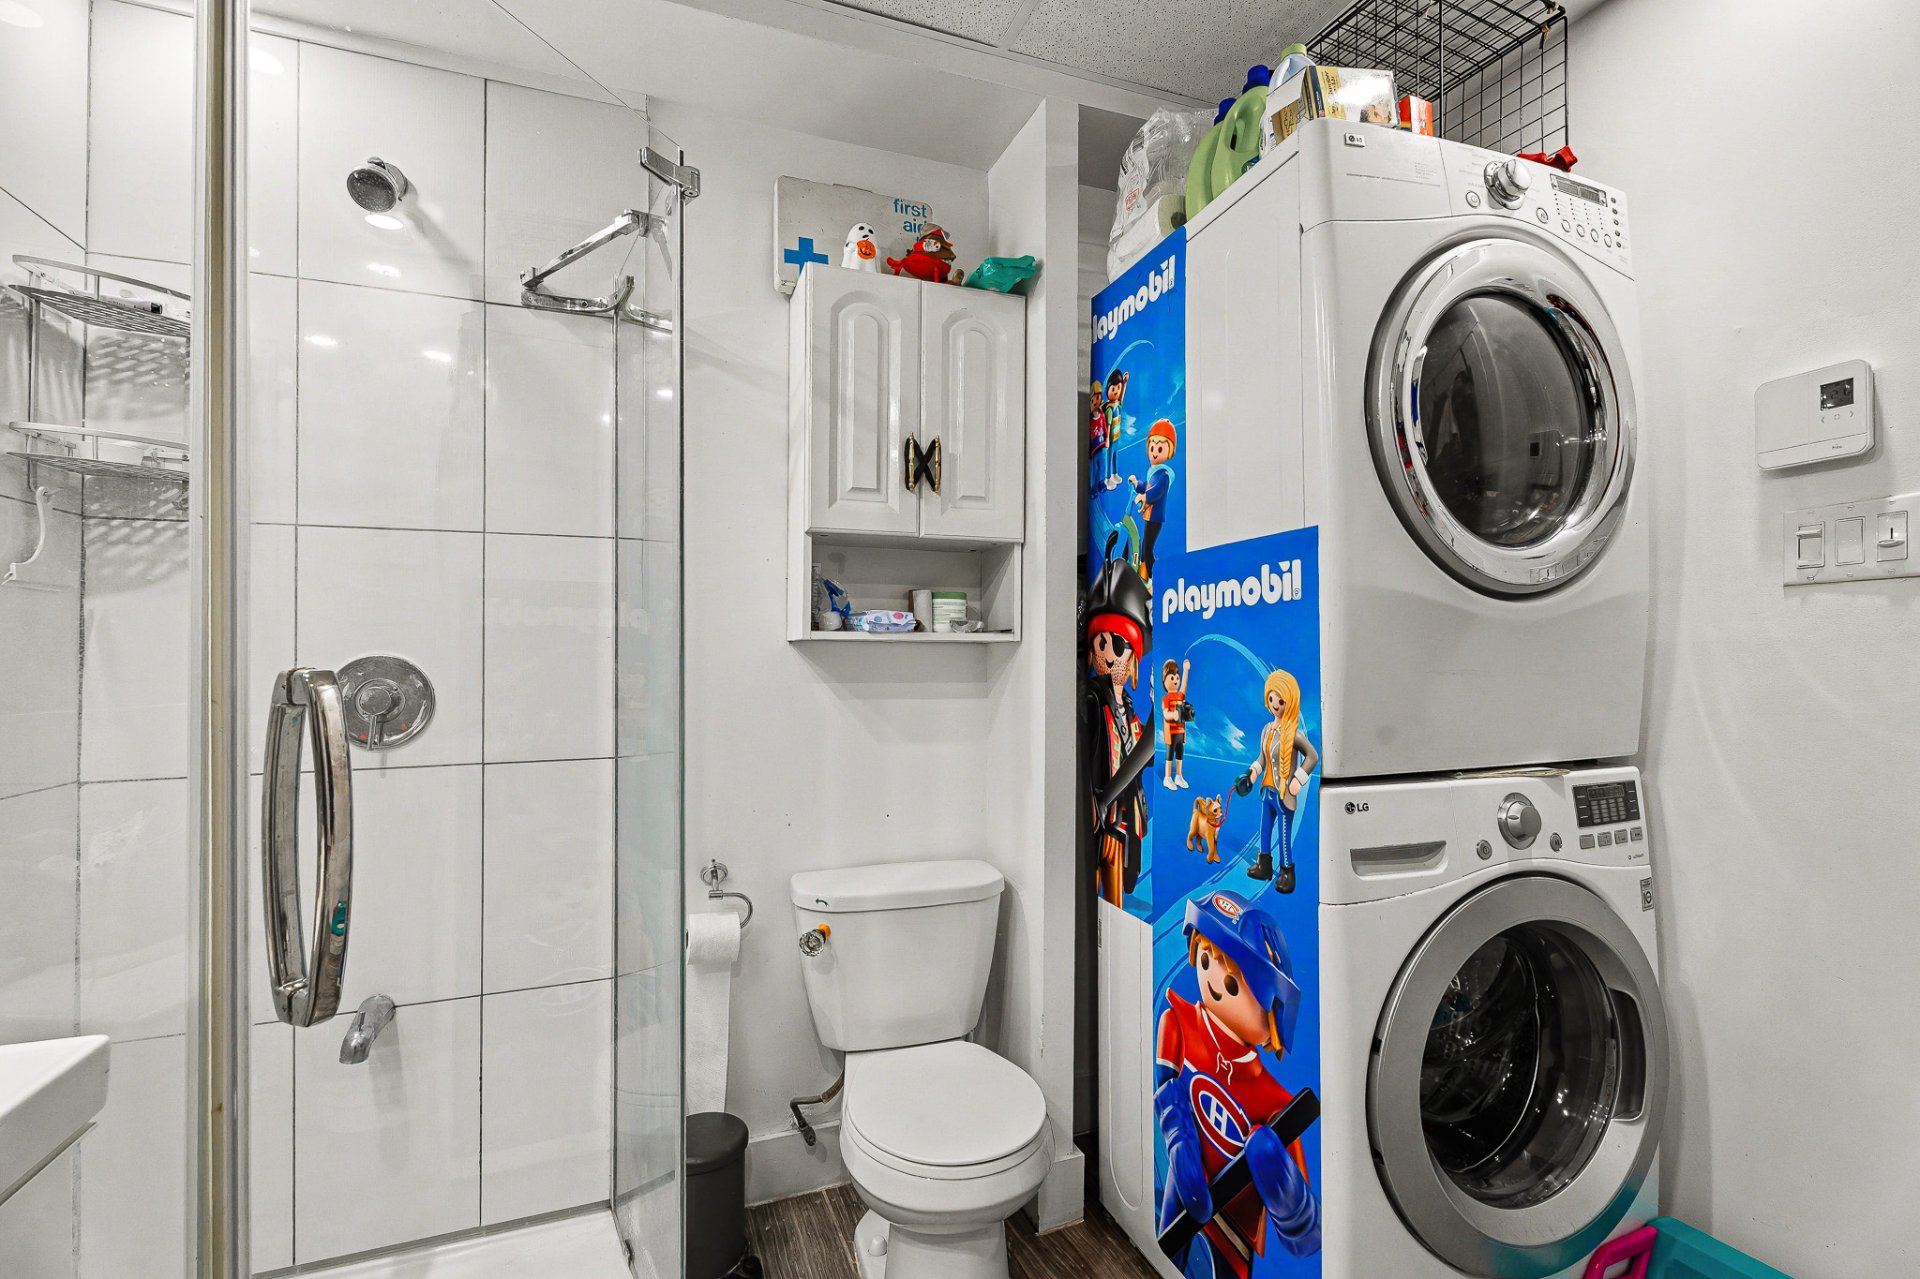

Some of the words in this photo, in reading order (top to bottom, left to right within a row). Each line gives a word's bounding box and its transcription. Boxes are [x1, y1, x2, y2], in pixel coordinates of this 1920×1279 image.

[893, 198, 927, 218] first
[1092, 254, 1176, 344] laymobil
[1162, 558, 1302, 623] playmobil
[1356, 802, 1370, 812] LG
